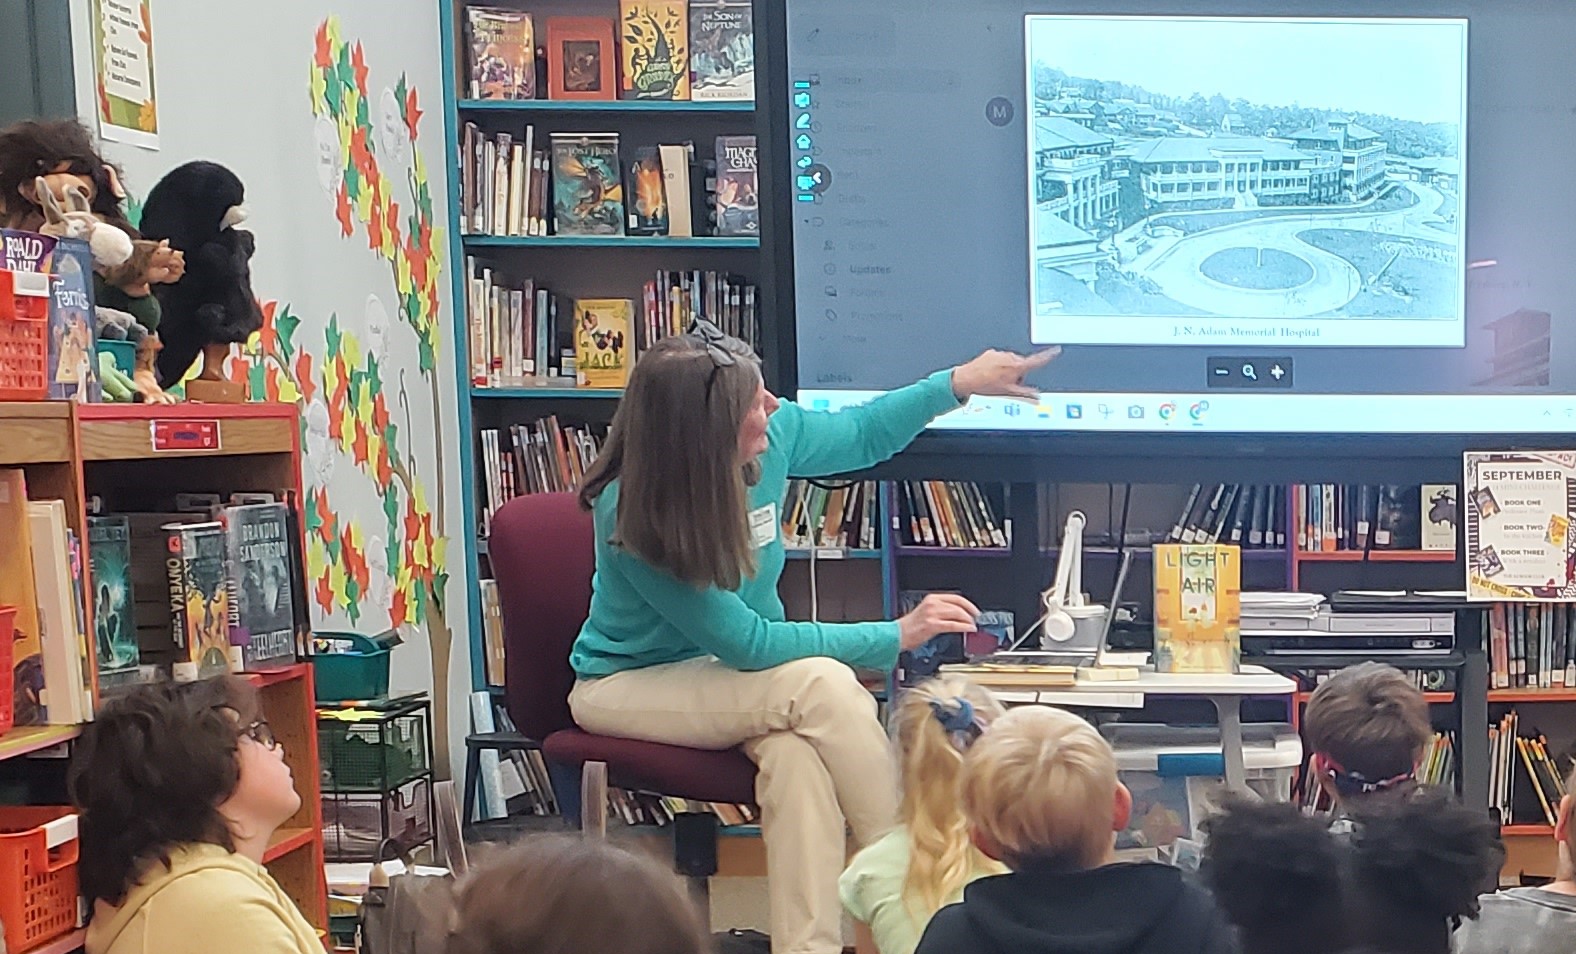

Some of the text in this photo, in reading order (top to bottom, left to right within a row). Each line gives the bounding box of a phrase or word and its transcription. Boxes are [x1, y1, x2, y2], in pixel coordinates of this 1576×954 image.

[713, 10, 733, 21] SON
[702, 21, 742, 31] NEPTUNE
[992, 105, 1007, 119] M
[5, 236, 43, 260] ROALD
[850, 264, 892, 276] Updates
[1183, 326, 1196, 336] N.
[1199, 327, 1227, 337] Adam
[1230, 327, 1276, 337] Memorial
[1280, 327, 1320, 339] Hospital
[1482, 470, 1562, 481] SEPTEMBER
[242, 522, 280, 541] BRANDON
[239, 541, 287, 563] SANDERSON
[1166, 552, 1230, 568] LIGHT
[166, 557, 185, 613] ONYEKA
[1181, 577, 1216, 593] AIR
[1472, 576, 1480, 585] DO
[1480, 579, 1491, 588] NOT
